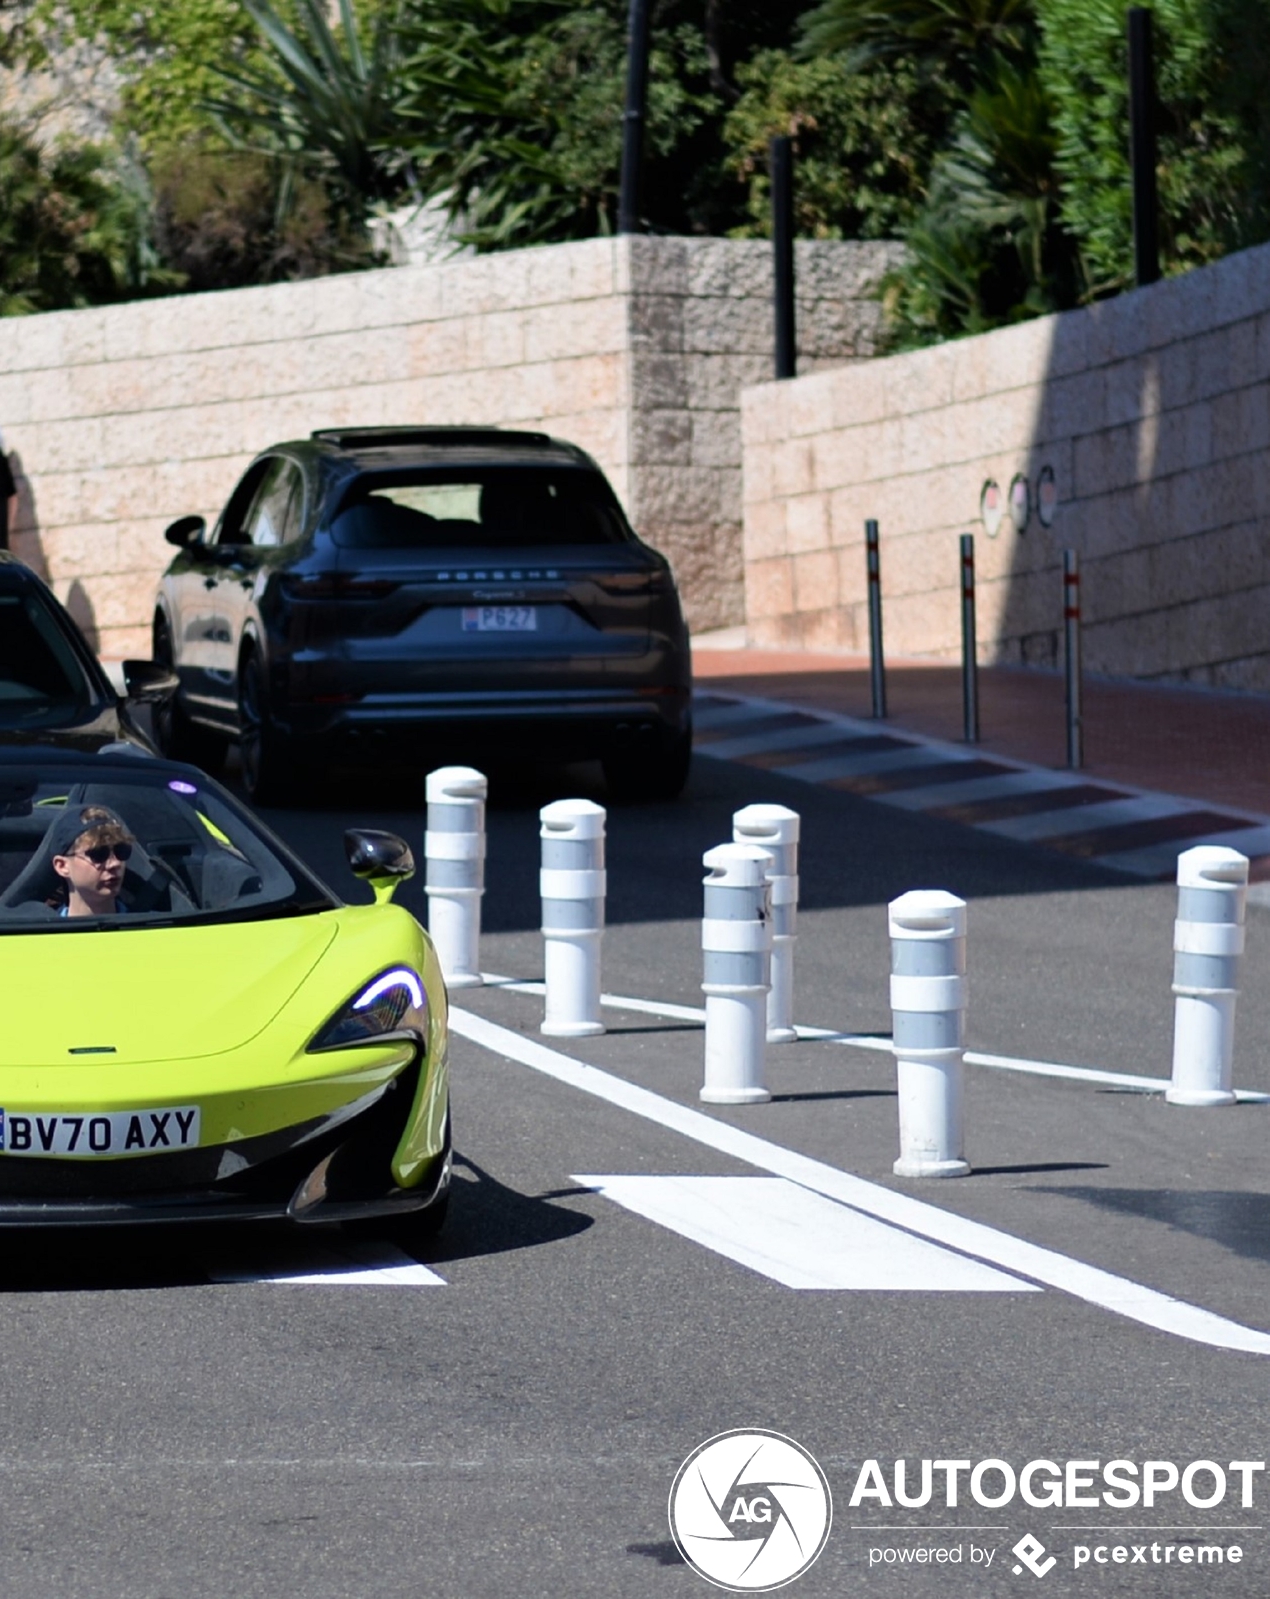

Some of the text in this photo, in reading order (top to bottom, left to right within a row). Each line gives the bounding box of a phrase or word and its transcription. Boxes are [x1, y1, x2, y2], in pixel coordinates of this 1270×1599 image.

[437, 570, 558, 580] PORSCHE
[482, 608, 533, 628] P627
[9, 1110, 196, 1152] BV70 AXY
